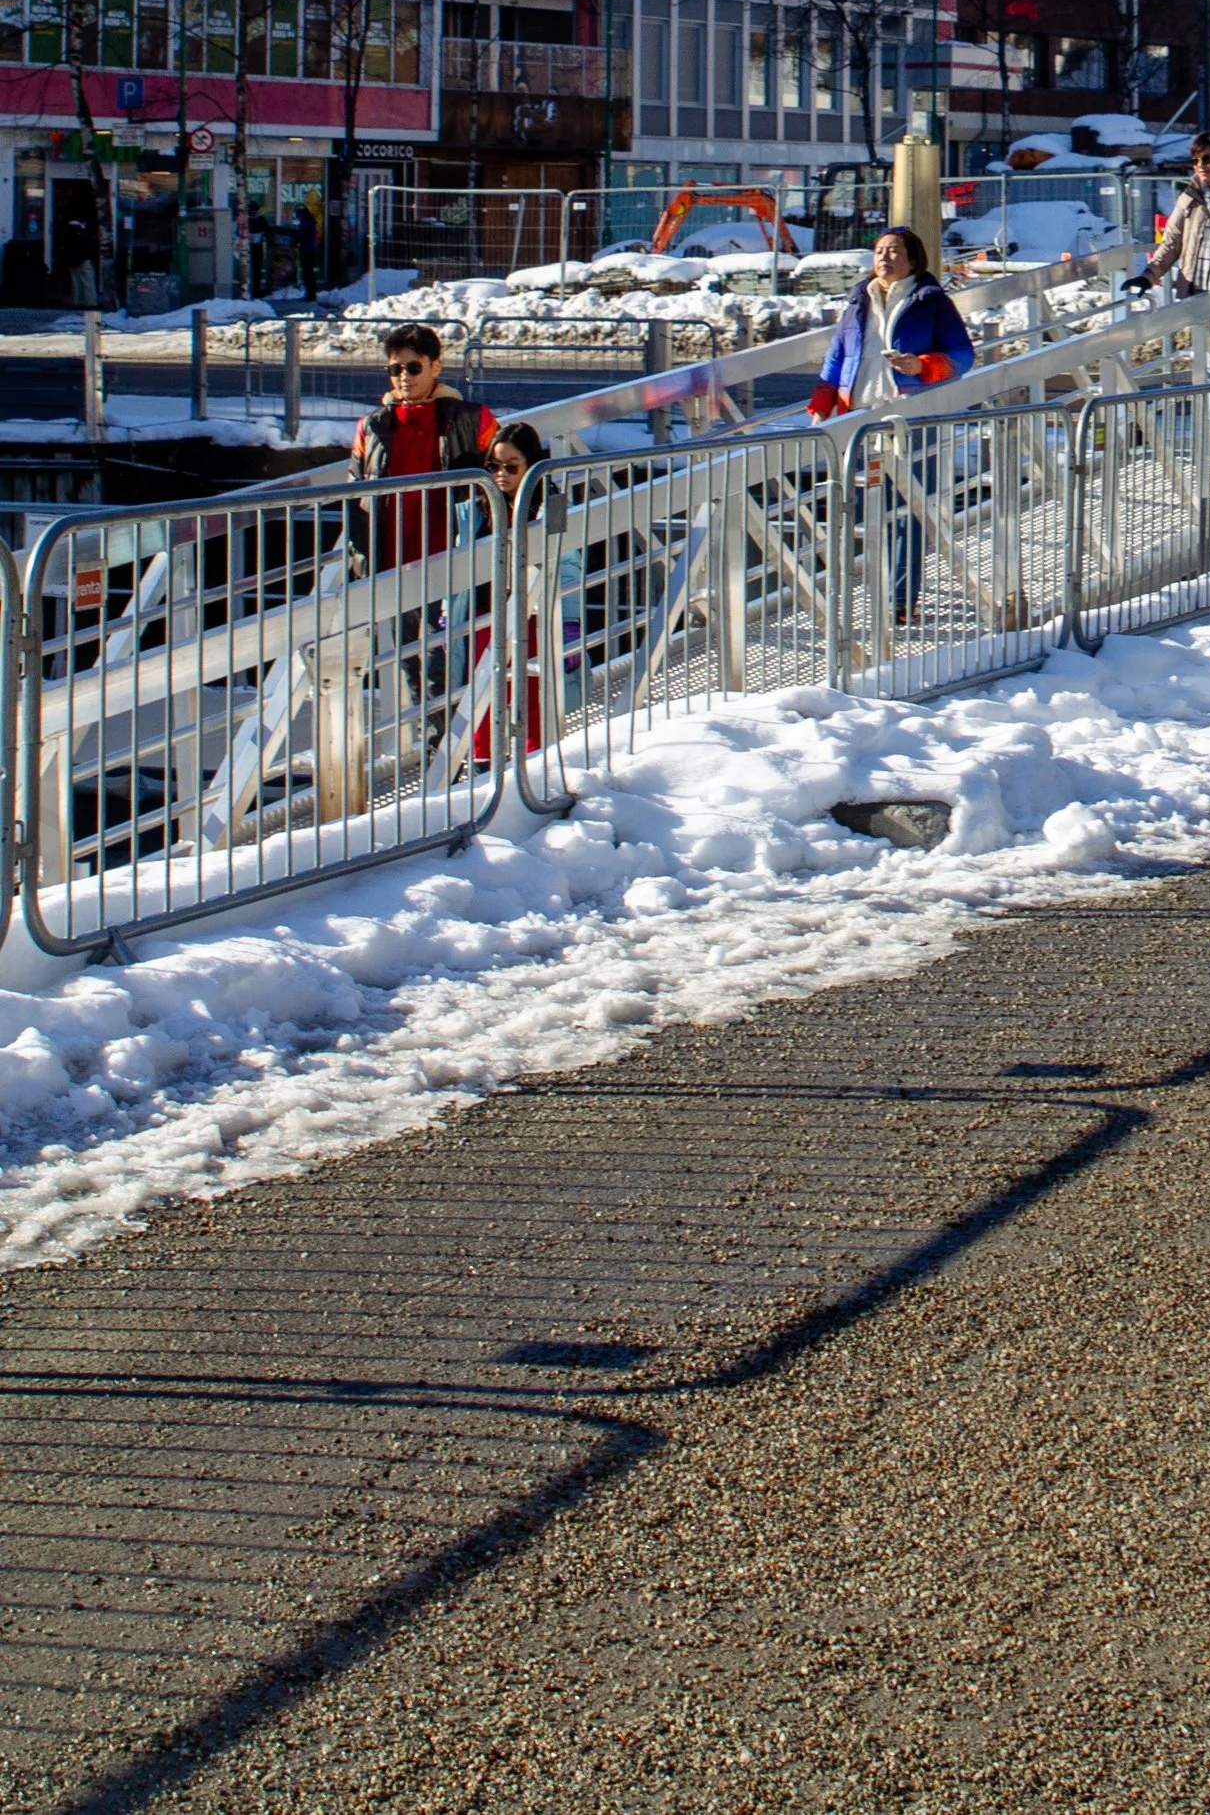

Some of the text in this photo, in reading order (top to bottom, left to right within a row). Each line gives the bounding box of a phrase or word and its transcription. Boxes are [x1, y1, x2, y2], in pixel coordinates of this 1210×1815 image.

[123, 81, 136, 105] P
[356, 143, 414, 158] COCORICO
[76, 581, 103, 597] renta
